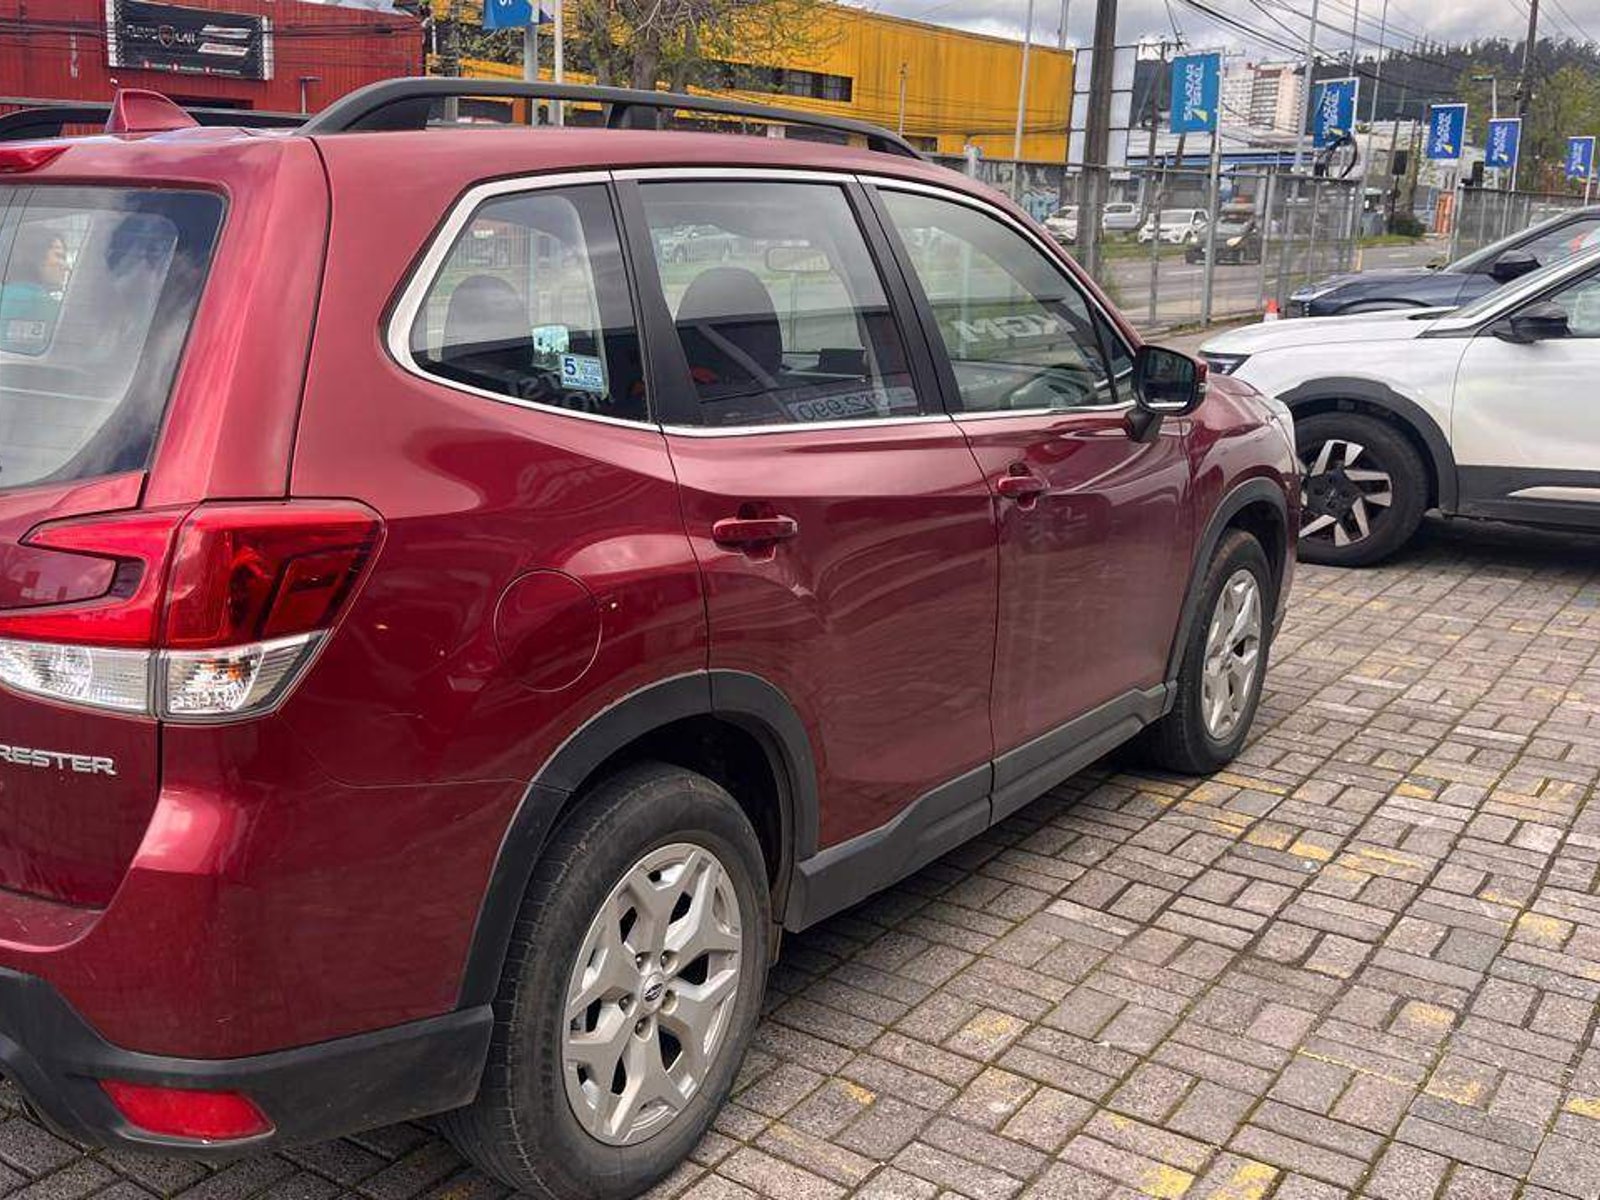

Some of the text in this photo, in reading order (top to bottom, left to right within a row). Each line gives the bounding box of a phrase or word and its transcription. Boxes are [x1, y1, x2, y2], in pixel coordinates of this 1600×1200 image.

[1183, 64, 1194, 121] SALAZAR
[564, 357, 576, 376] 5
[0, 744, 118, 776] RESTER
